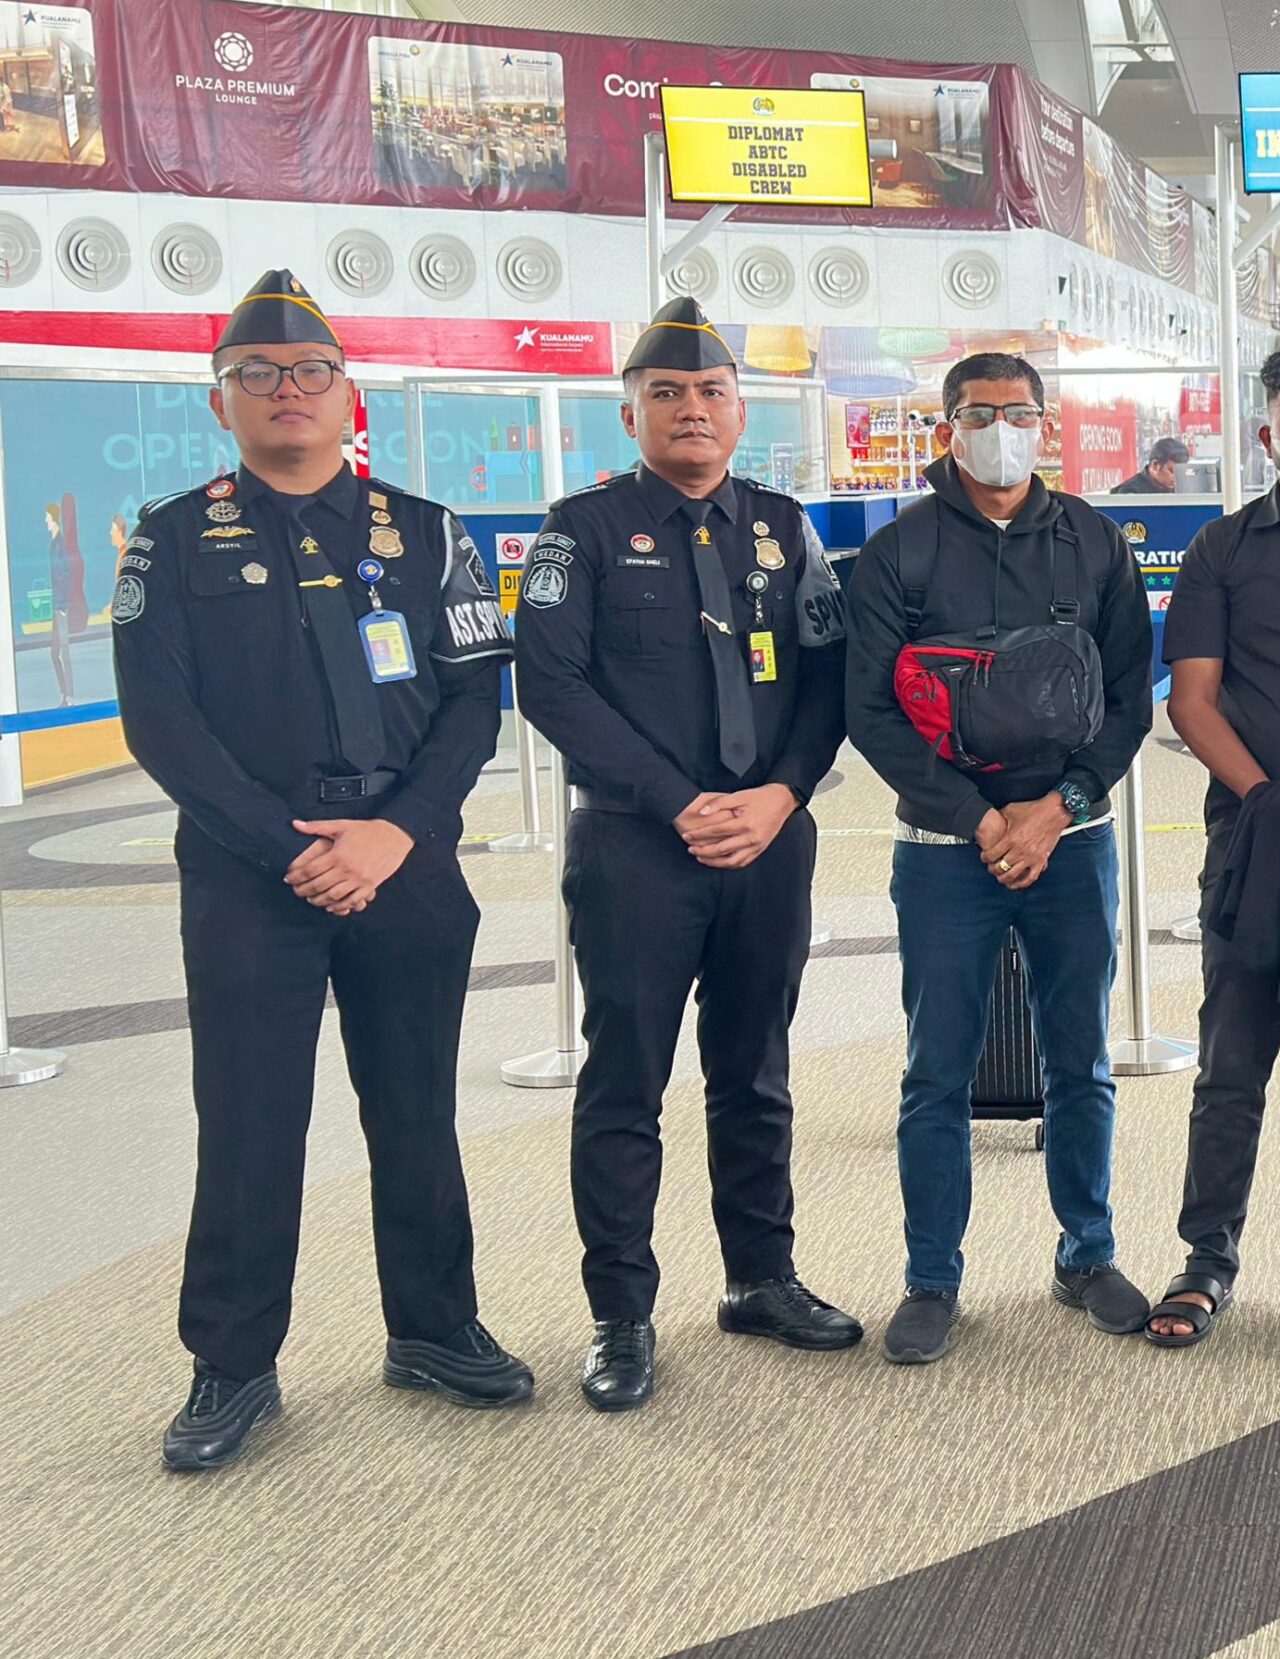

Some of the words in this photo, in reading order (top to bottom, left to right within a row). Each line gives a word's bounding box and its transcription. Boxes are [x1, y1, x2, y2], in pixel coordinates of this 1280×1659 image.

[175, 74, 224, 91] PLAZA
[227, 79, 295, 97] PREMIUM
[603, 73, 668, 99] Com
[215, 93, 257, 105] LOUNGE
[727, 125, 804, 141] DIPLOMAT
[748, 144, 788, 160] ABTC
[732, 161, 807, 178] DISABLED
[750, 180, 792, 195] CREW
[540, 333, 594, 343] KUALANAMU
[102, 432, 241, 476] OPEN
